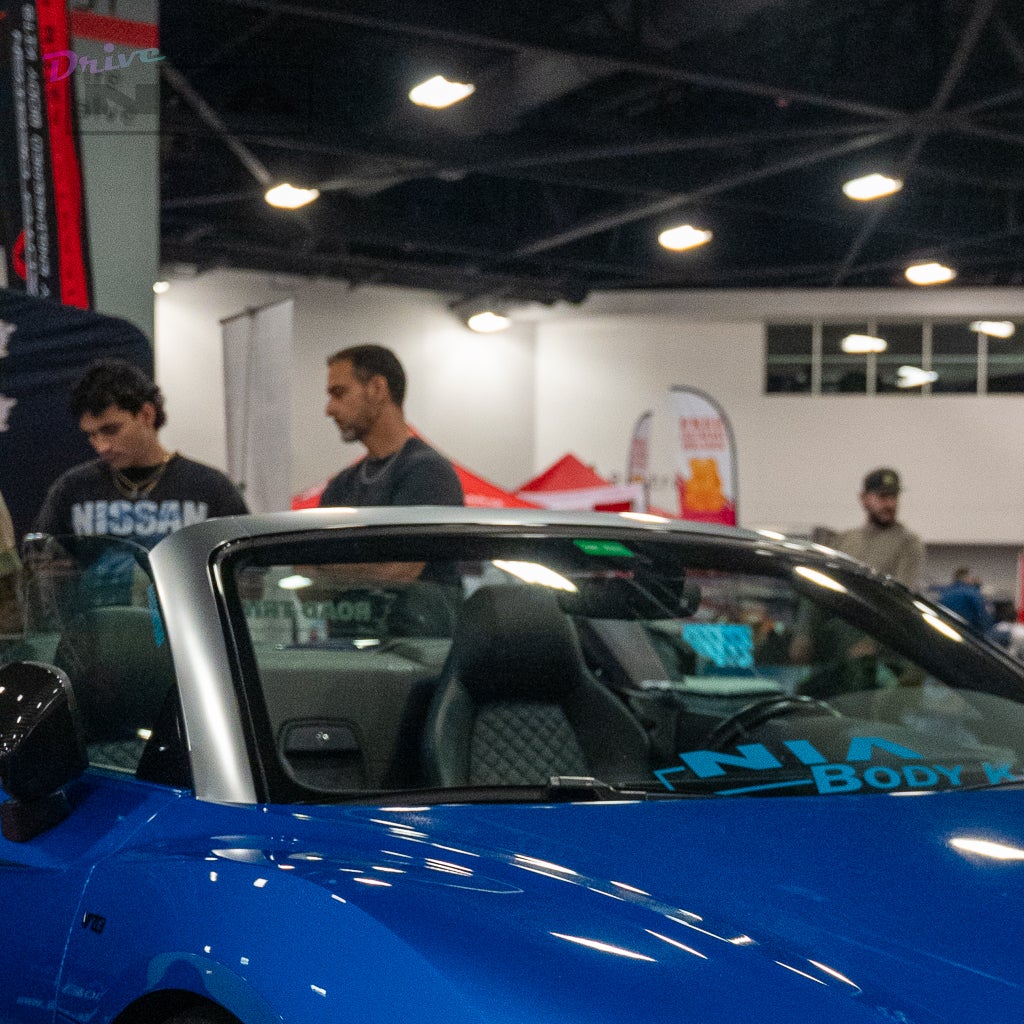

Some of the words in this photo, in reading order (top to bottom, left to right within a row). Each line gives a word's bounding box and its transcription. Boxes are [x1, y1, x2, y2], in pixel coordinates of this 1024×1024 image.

[71, 500, 208, 537] NISSAN
[679, 737, 925, 778] NIA
[810, 762, 963, 795] BODY
